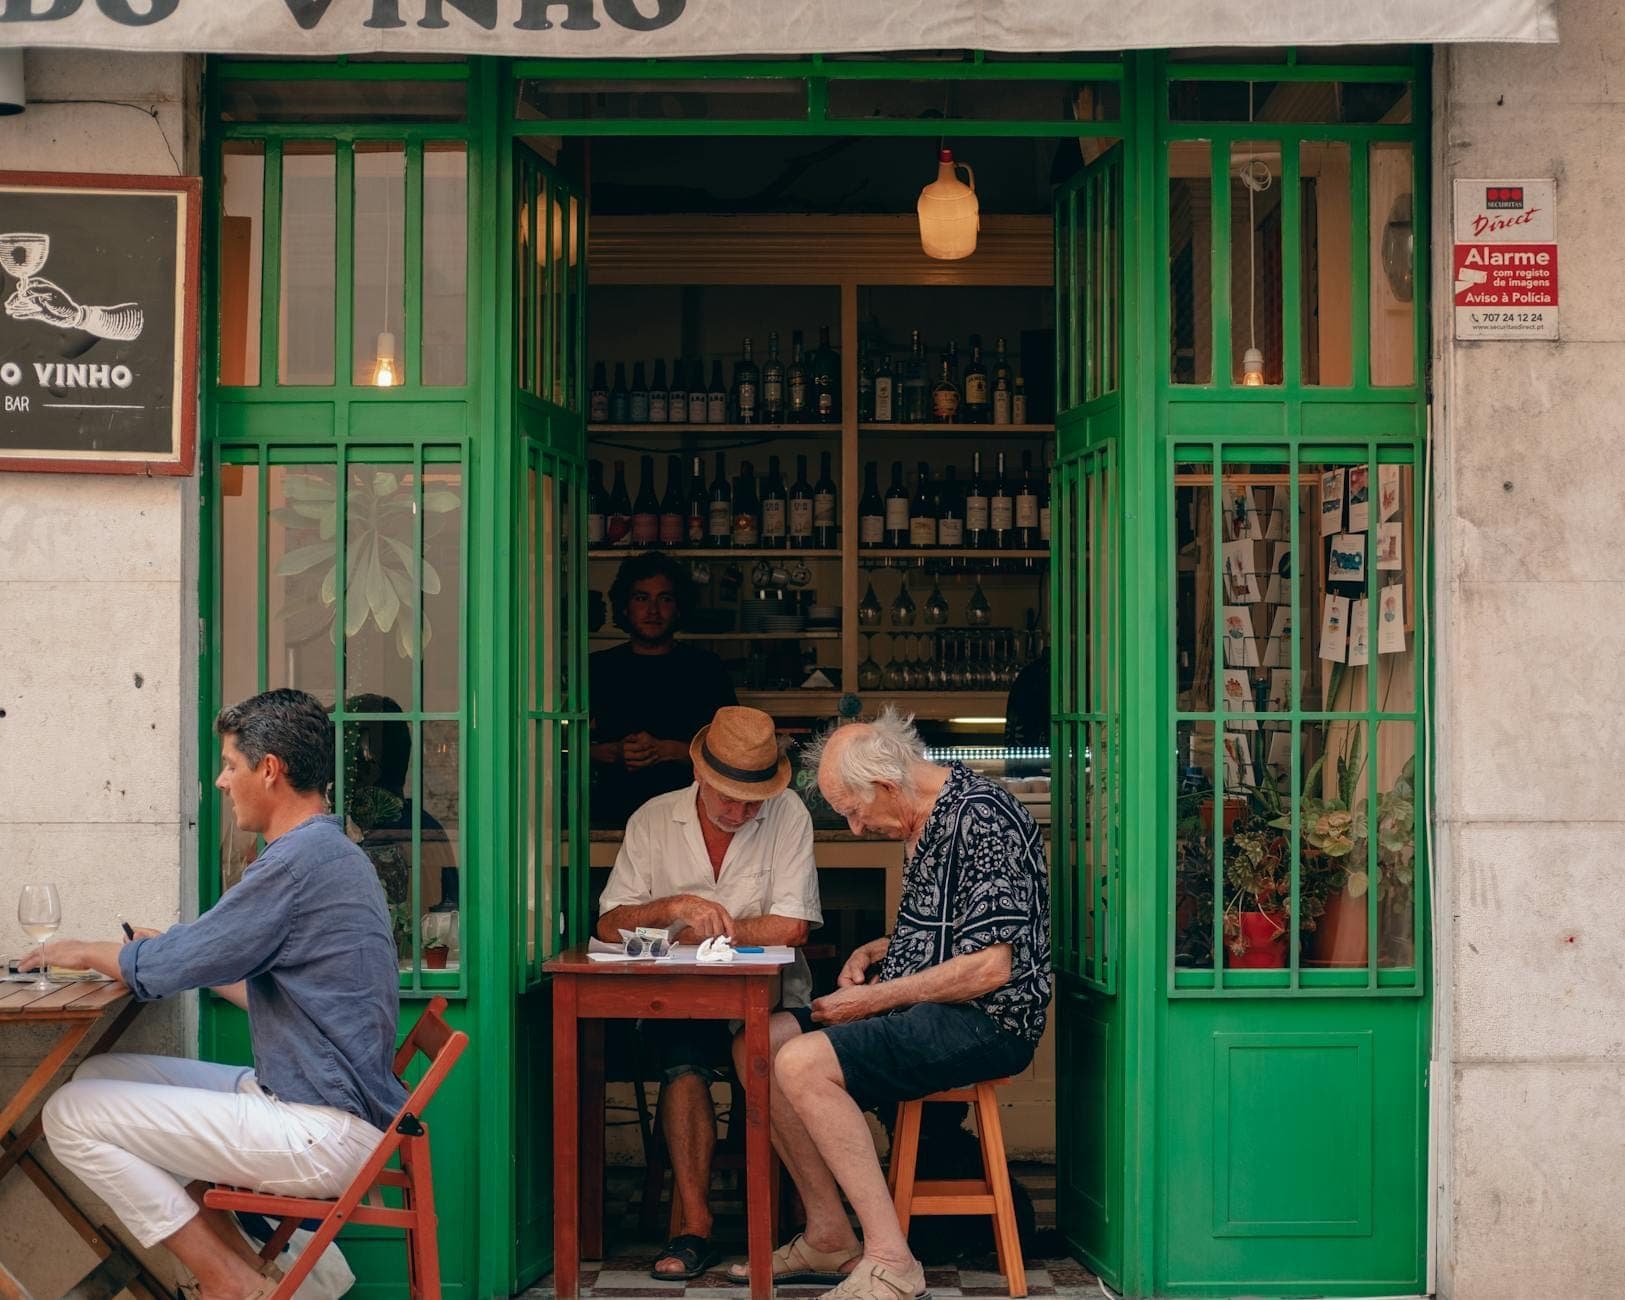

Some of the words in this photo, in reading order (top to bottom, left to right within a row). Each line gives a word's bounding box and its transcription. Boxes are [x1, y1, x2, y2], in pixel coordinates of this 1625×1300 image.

[1472, 208, 1543, 236] Direct
[1464, 246, 1550, 265] Alarme
[1493, 269, 1513, 277] com
[1516, 268, 1550, 279] registo
[1493, 277, 1506, 287] de
[1508, 277, 1550, 288] imagens
[1465, 292, 1498, 303] Aviso
[1501, 292, 1509, 303] à
[1512, 292, 1551, 303] Polícia
[1482, 313, 1500, 322] 707
[1502, 313, 1514, 322] 24
[1518, 313, 1529, 322] 12
[1530, 313, 1543, 322] 24
[33, 362, 133, 389] VINHO
[4, 395, 30, 412] BAR
